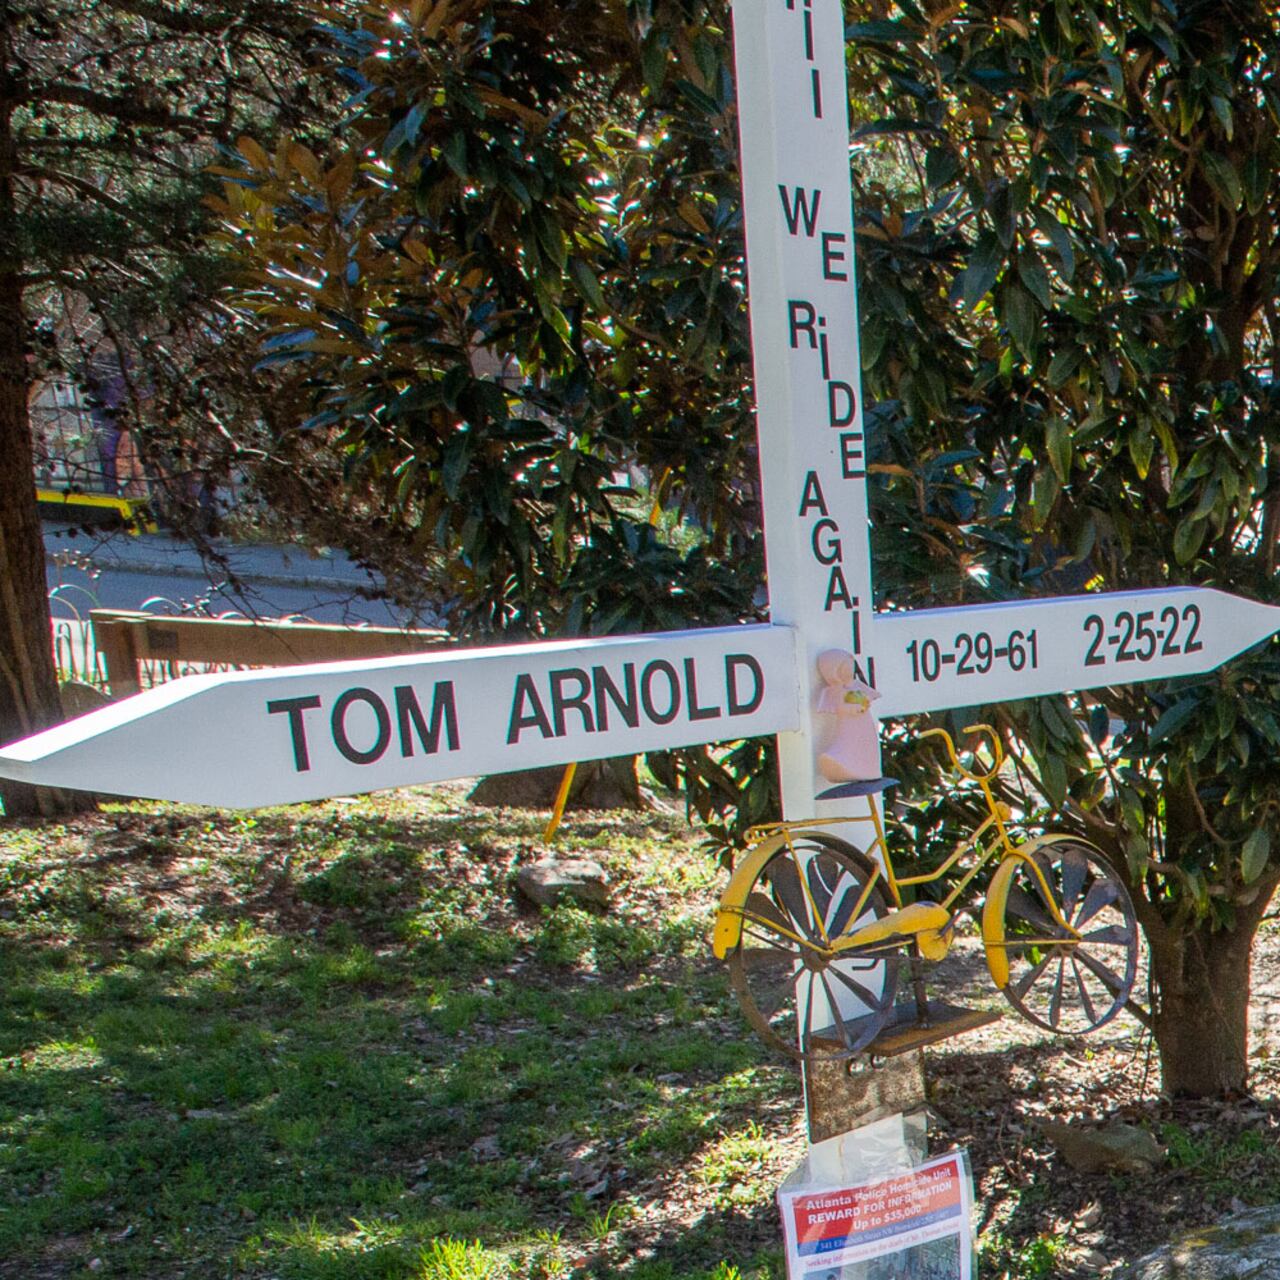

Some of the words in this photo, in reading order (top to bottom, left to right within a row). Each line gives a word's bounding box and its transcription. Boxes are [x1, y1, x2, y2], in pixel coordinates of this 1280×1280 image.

[778, 184, 848, 282] WE
[906, 629, 1039, 682] 10-29-61
[1083, 604, 1203, 666] 2-25-22
[267, 680, 460, 772] TOM
[506, 653, 765, 744] ARNOLD
[806, 1196, 851, 1211] Atlanta
[854, 1189, 887, 1202] Police
[933, 1167, 951, 1181] Unit
[807, 1206, 861, 1225] REWARD
[863, 1200, 886, 1214] FOR
[888, 1180, 952, 1207] INFORMATION
[854, 1218, 868, 1232] Up
[871, 1213, 881, 1225] to
[884, 1205, 922, 1223] $35,000
